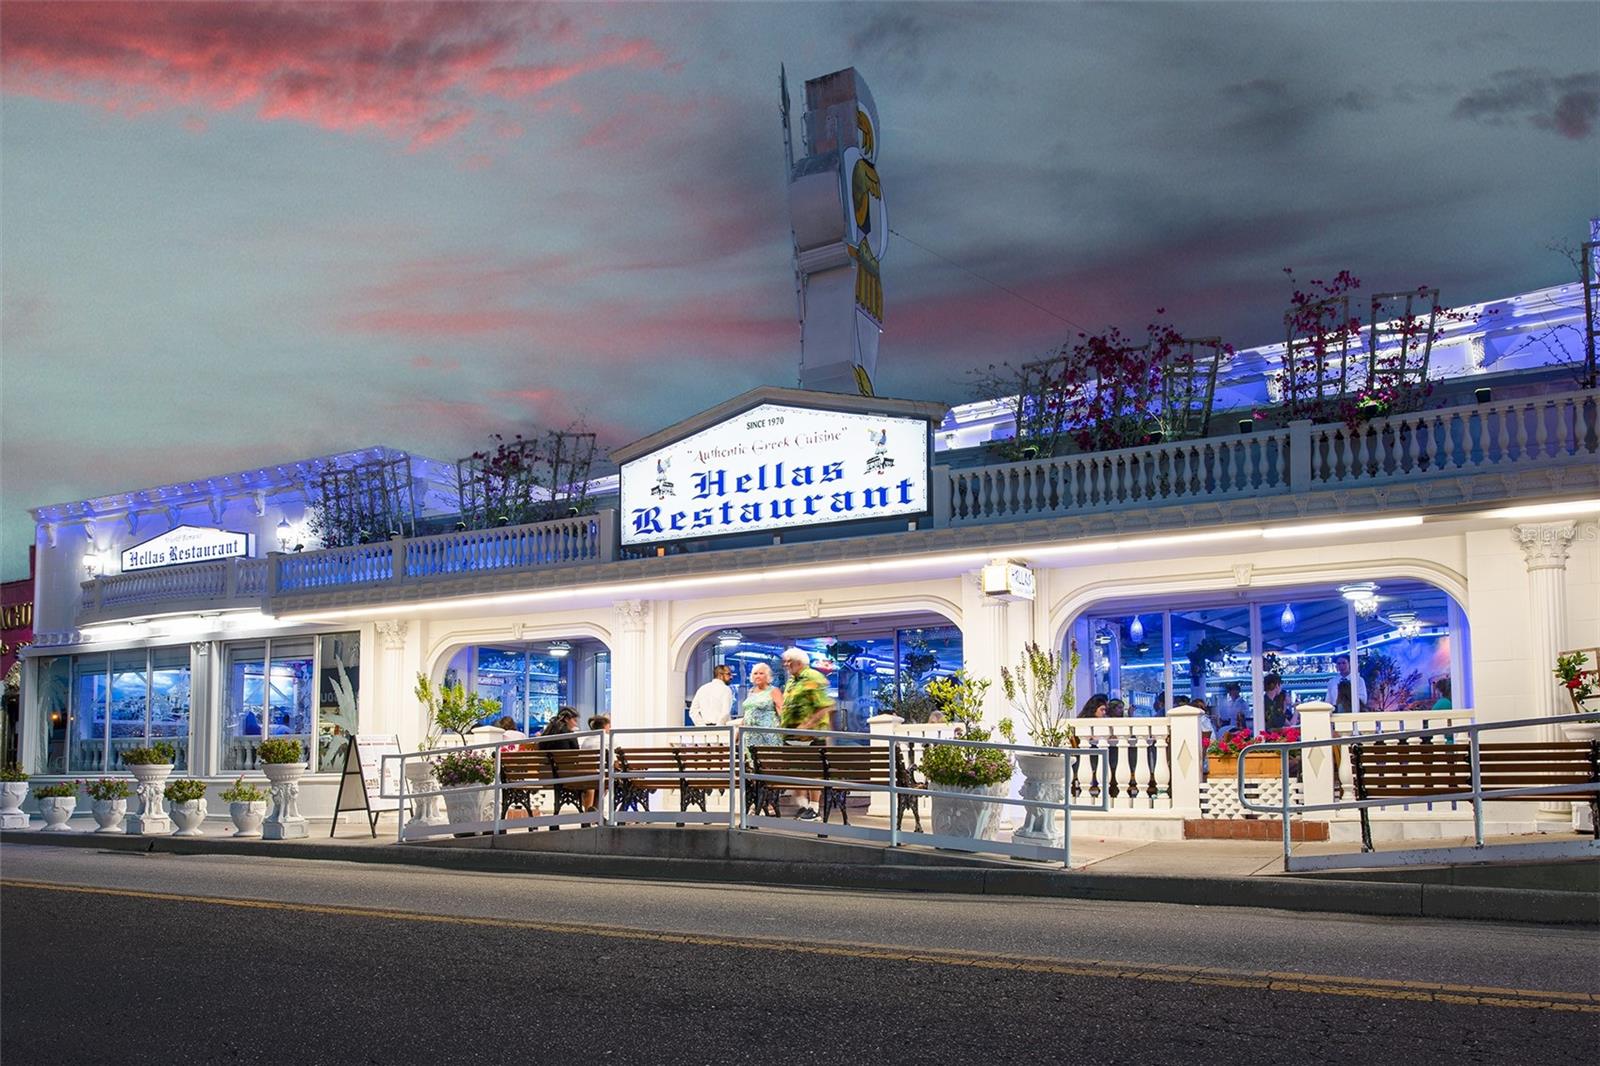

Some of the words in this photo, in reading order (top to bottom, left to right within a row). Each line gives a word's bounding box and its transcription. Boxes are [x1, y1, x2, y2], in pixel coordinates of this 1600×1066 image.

[746, 419, 766, 430] SINCE
[768, 416, 785, 426] 1970
[751, 435, 790, 456] Greek
[690, 461, 845, 500] Hellas
[632, 477, 914, 536] Restaurant
[129, 550, 165, 567] Hellas
[168, 539, 238, 562] Restaurant
